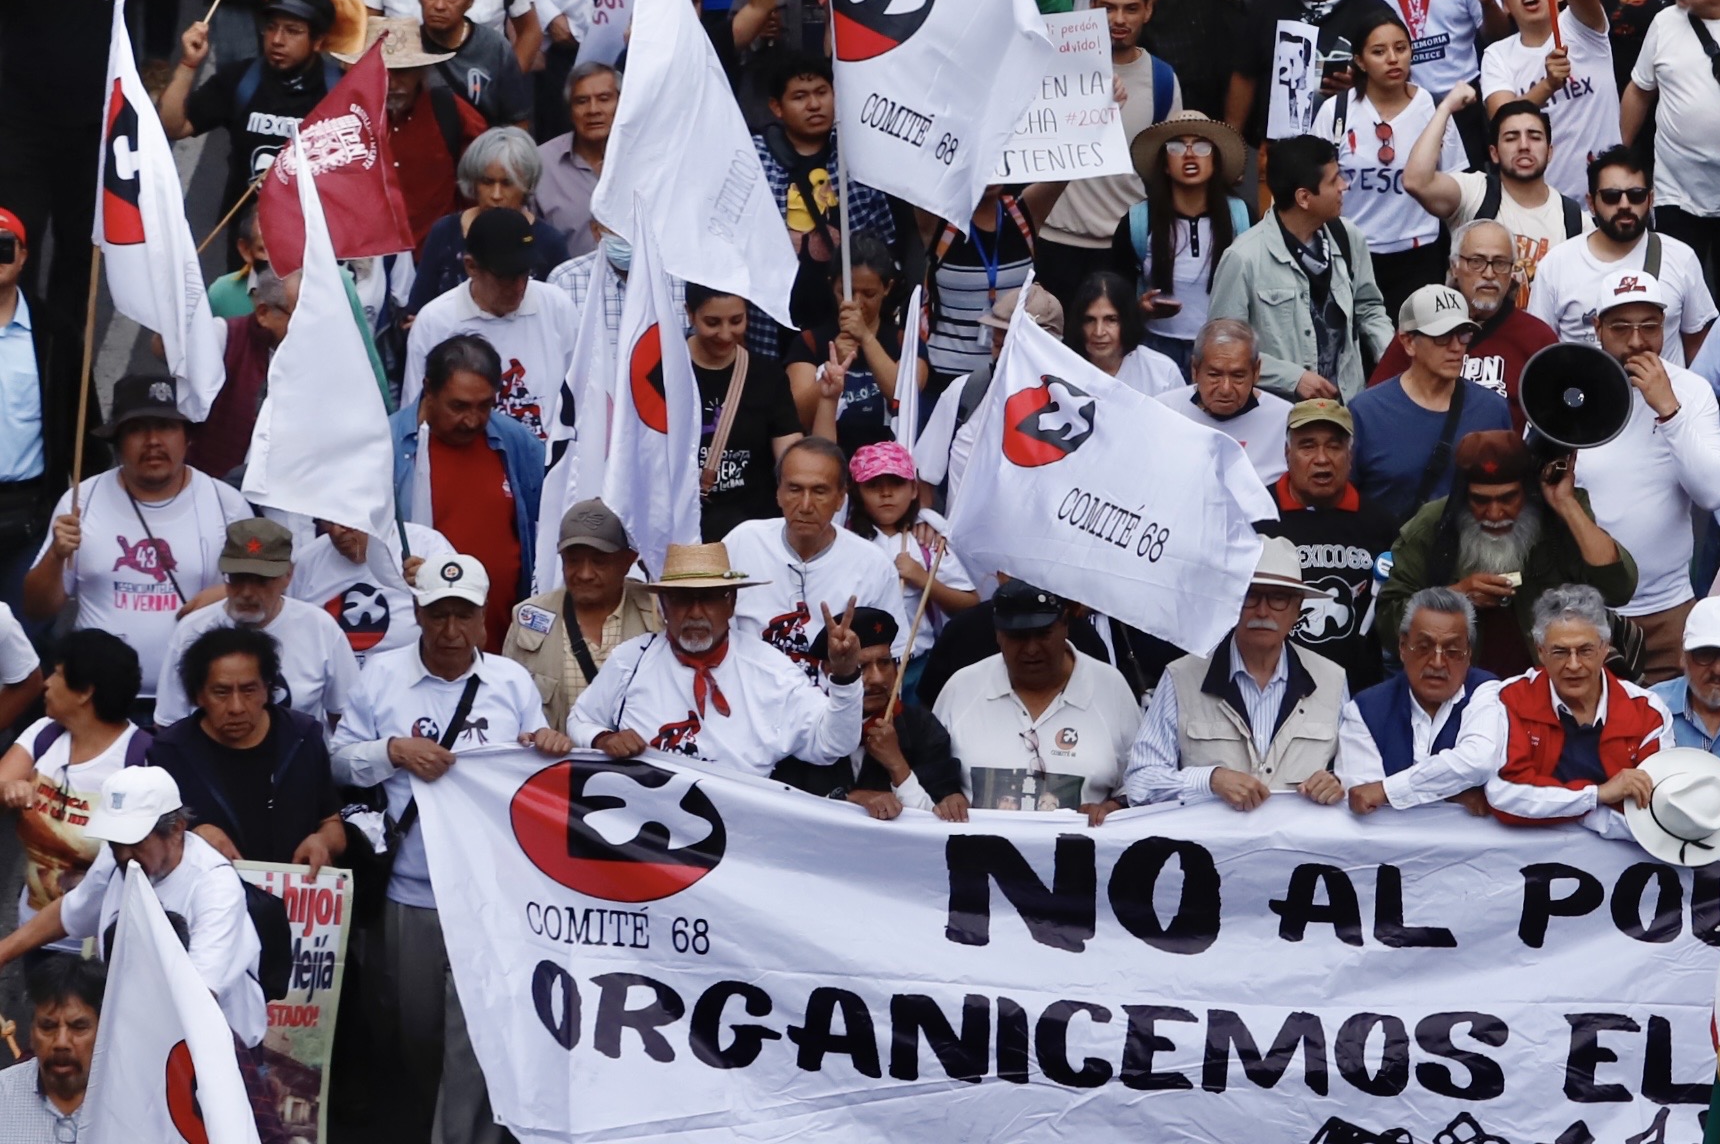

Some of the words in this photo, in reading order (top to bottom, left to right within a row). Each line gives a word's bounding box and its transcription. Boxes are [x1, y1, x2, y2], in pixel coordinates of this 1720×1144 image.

[1061, 16, 1099, 38] perdón
[1042, 75, 1067, 101] EN
[1079, 71, 1106, 97] LA
[860, 92, 936, 150] COMITÉ
[935, 130, 960, 167] 68
[1057, 486, 1142, 560] COMITÉ
[1135, 521, 1171, 564] 68
[136, 546, 158, 569] 43
[113, 593, 129, 610] LA
[132, 593, 178, 612] VERDAD
[945, 831, 1222, 956] NO
[1268, 862, 1459, 948] AL
[525, 901, 650, 950] COMITÉ
[671, 917, 711, 956] 68
[531, 959, 1510, 1103] ORGANICEMOS
[1564, 1010, 1719, 1104] EL
